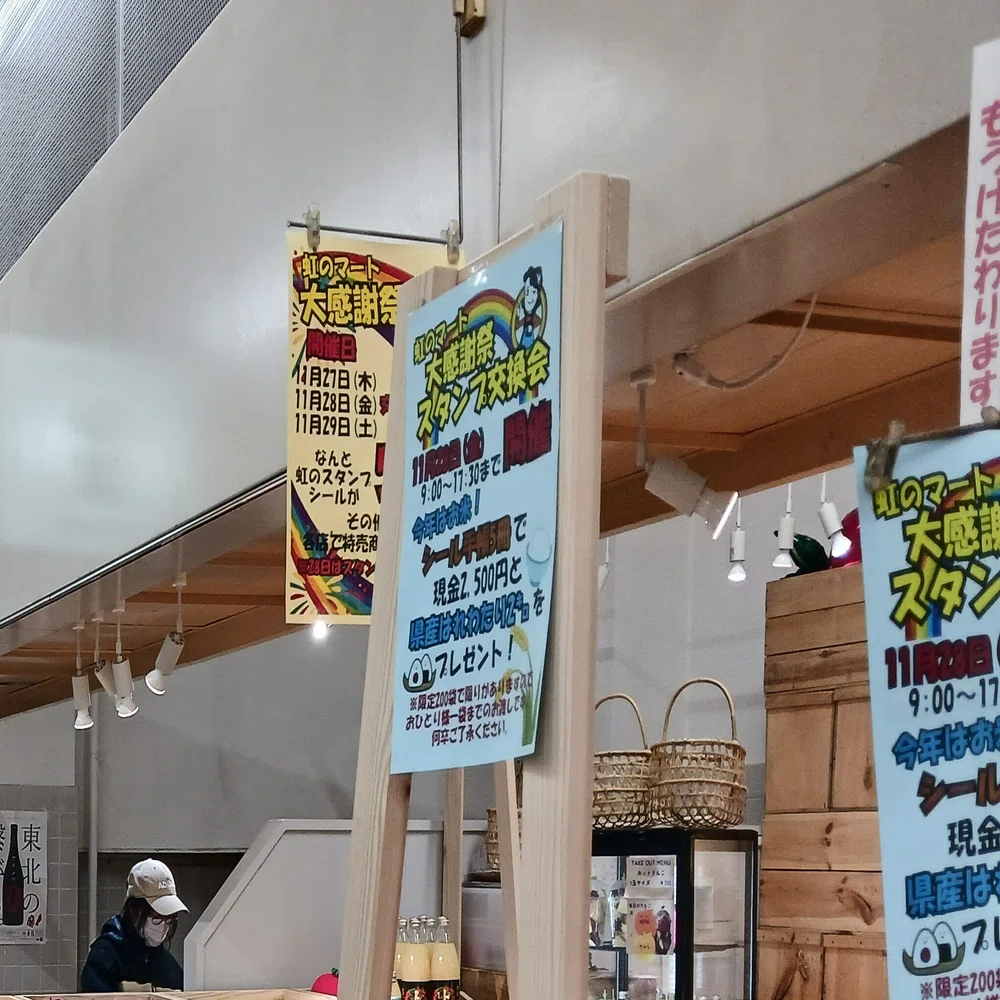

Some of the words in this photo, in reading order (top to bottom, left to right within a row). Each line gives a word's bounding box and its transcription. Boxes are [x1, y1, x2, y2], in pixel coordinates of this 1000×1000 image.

[301, 252, 380, 281] 虹のマート
[299, 281, 398, 327] 大感謝祭
[306, 328, 357, 362] 開催日
[413, 307, 468, 365] 虹のマート
[425, 316, 495, 392] 大感謝祭
[296, 388, 377, 415] 11月28日(金)
[416, 338, 550, 441] スタンプ交換会
[296, 413, 377, 438] 11月29日(土)
[296, 466, 371, 487] 虹のスタンプ
[315, 449, 351, 467] なんと
[309, 487, 359, 505] シールが
[873, 462, 995, 520] 虹のマート
[885, 633, 1000, 690] 11月28日
[892, 715, 1000, 771] 今年はお
[21, 823, 42, 913] 東北の
[905, 861, 1000, 919] 県産は
